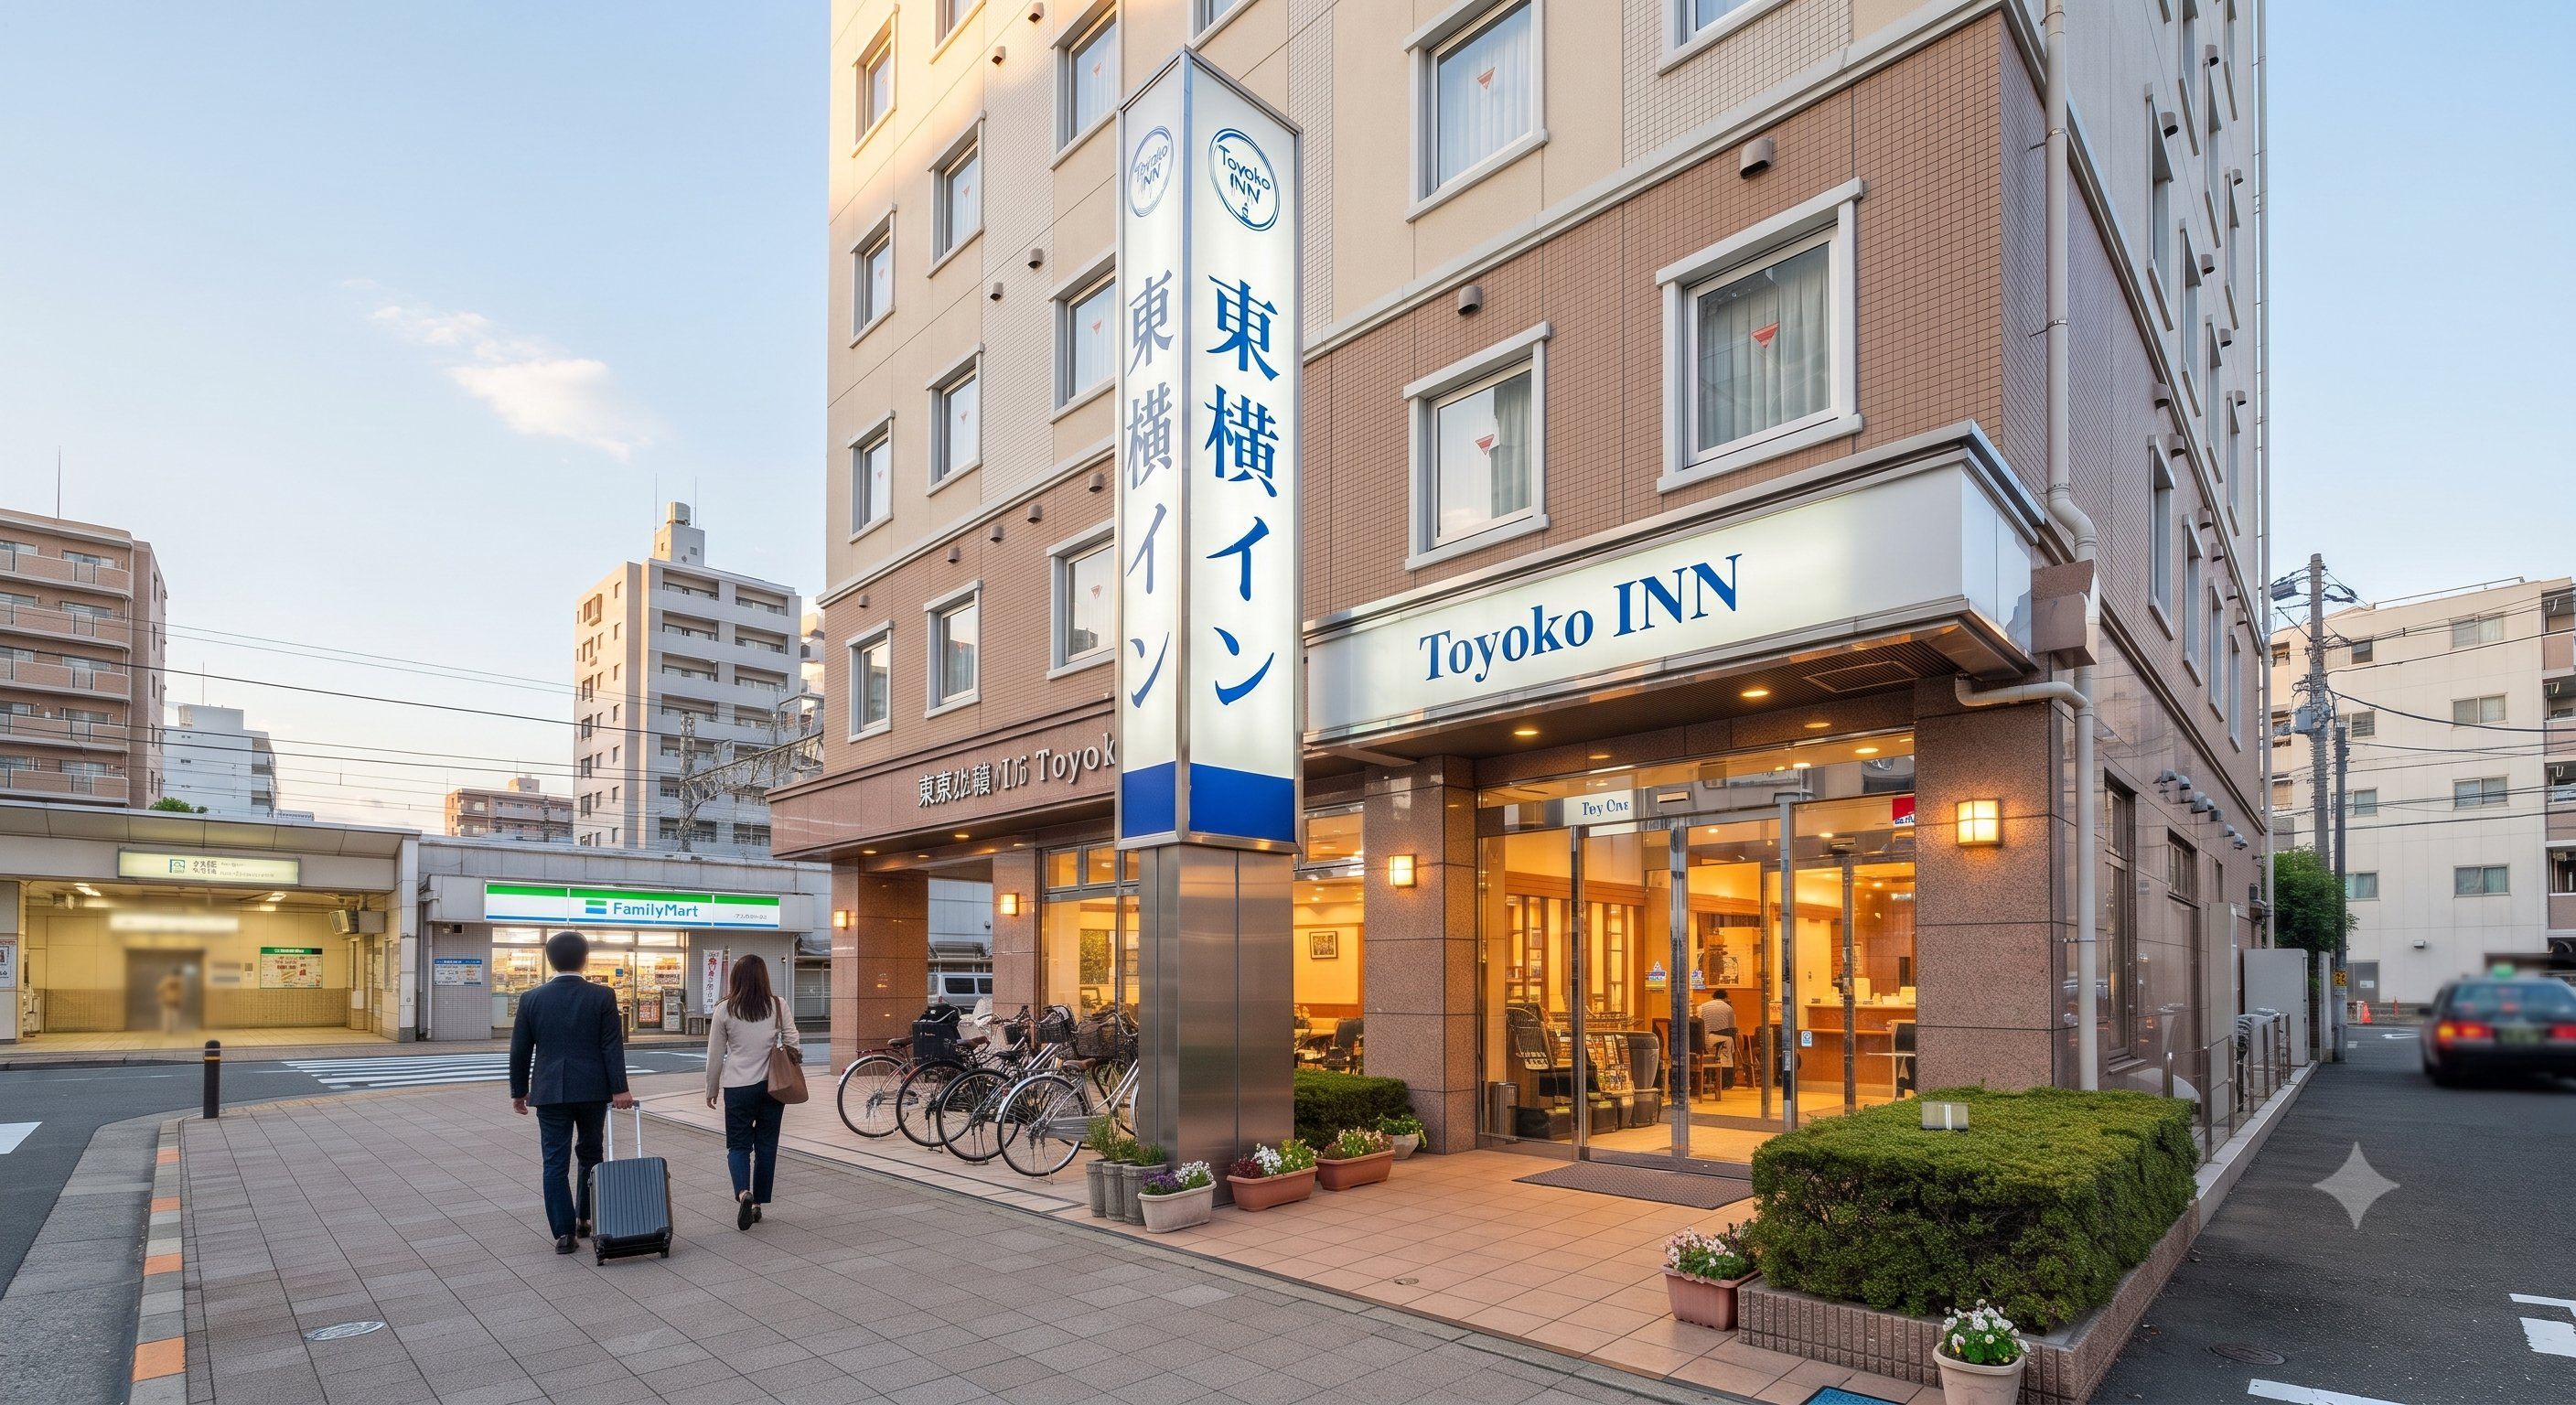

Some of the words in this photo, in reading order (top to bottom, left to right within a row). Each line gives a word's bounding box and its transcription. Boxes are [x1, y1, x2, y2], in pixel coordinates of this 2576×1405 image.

[1230, 173, 1261, 204] INN
[1126, 269, 1175, 709] 東横イン
[1204, 274, 1281, 706] 東横イン
[1419, 605, 1594, 683] Toyoko
[1613, 553, 1743, 638] INN
[613, 902, 699, 918] FamilyMart
